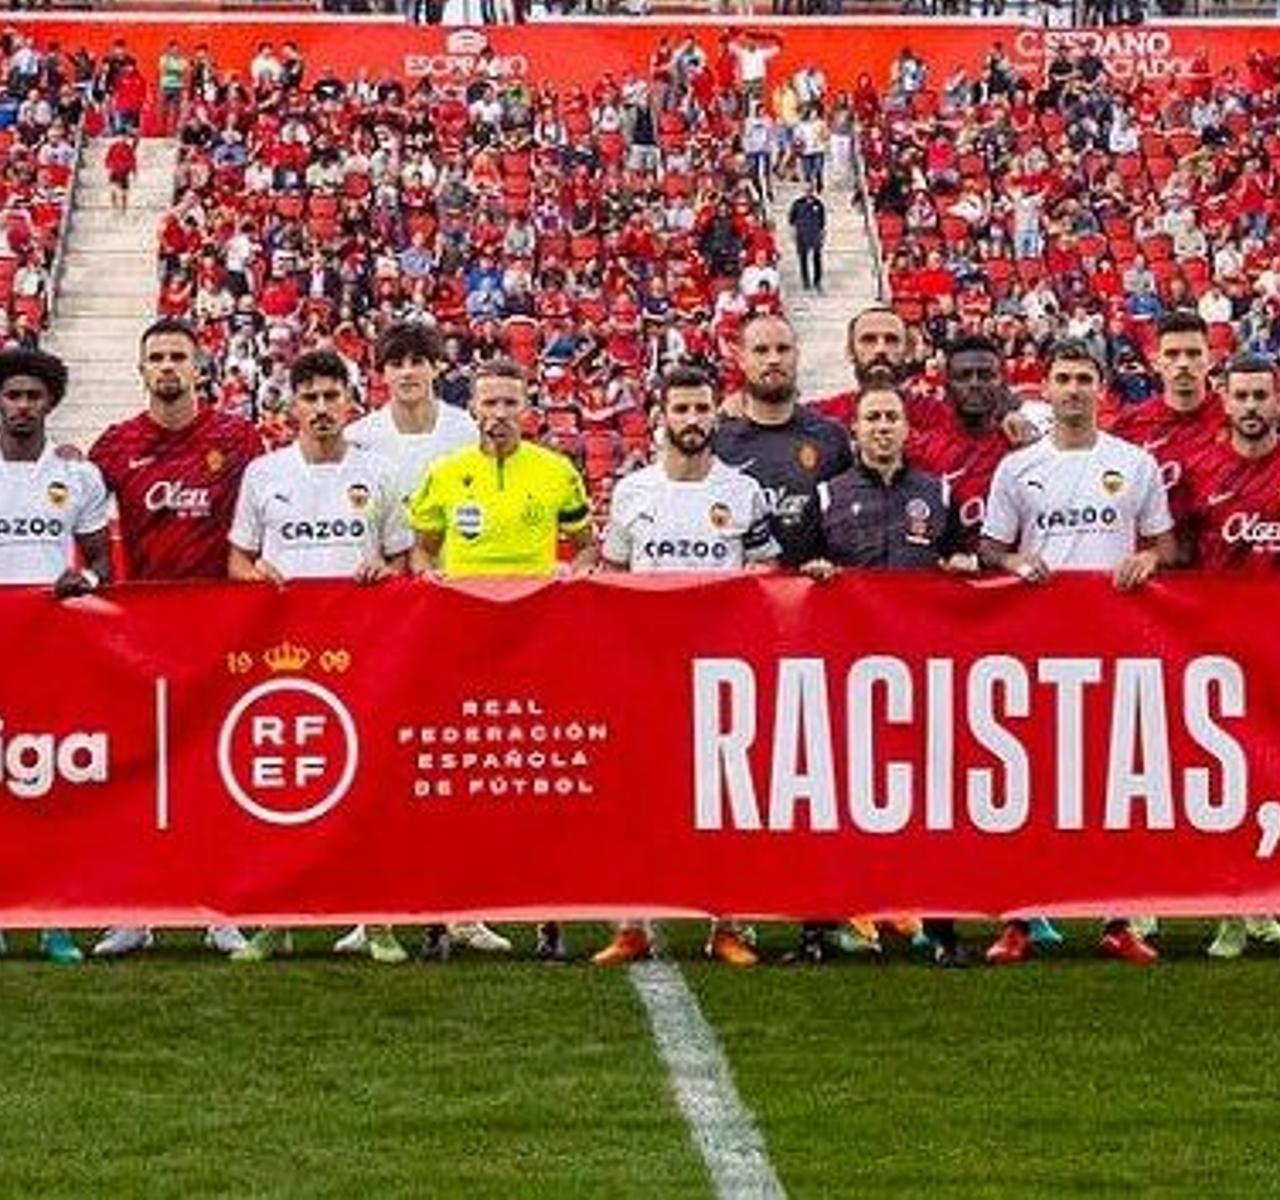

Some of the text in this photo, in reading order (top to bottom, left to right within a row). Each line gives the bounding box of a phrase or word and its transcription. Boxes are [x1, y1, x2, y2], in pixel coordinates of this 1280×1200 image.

[1036, 506, 1118, 530] CAZOO
[281, 520, 365, 540] CAZOO
[644, 539, 728, 559] CAZOO
[462, 699, 544, 717] REAL
[397, 722, 608, 744] FEDERACIÓN
[417, 749, 588, 769] ESPAÑOLA
[414, 776, 594, 796] DE FÚTBOL
